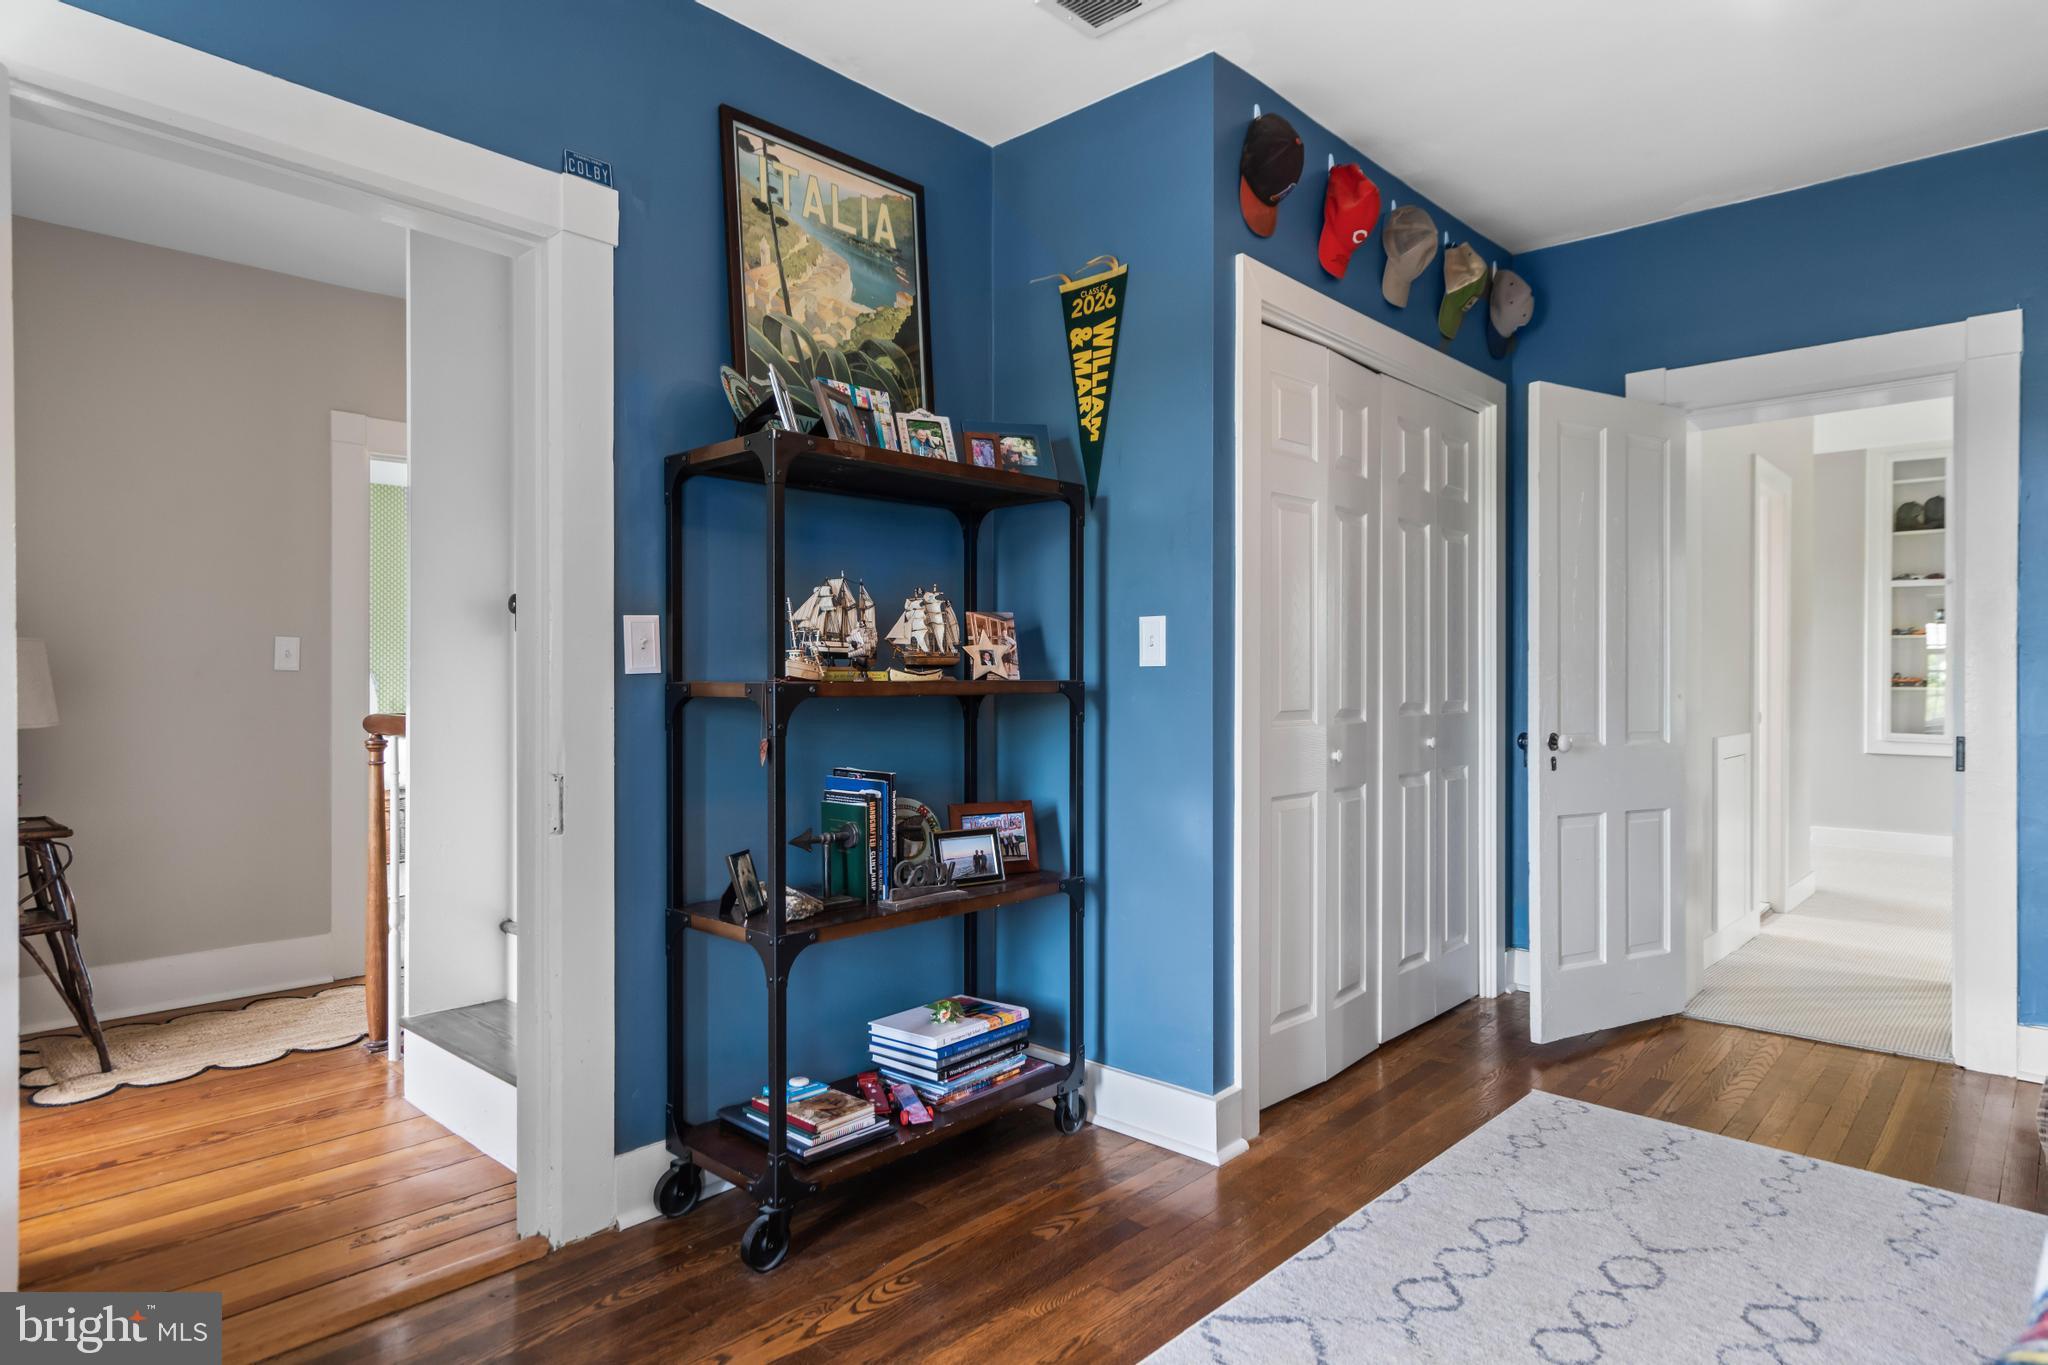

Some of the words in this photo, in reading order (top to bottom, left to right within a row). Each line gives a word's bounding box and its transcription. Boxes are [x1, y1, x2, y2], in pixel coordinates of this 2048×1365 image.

[568, 158, 608, 183] COLBY
[758, 155, 897, 249] ITALIA
[1352, 229, 1368, 244] C
[1071, 288, 1116, 318] 2026
[1080, 286, 1100, 298] CLASS
[1100, 283, 1108, 293] OF
[1070, 326, 1093, 349] &
[1072, 349, 1093, 436] MARY
[1090, 316, 1117, 442] WILLIAM
[869, 801, 877, 848] HANDCRAFTED
